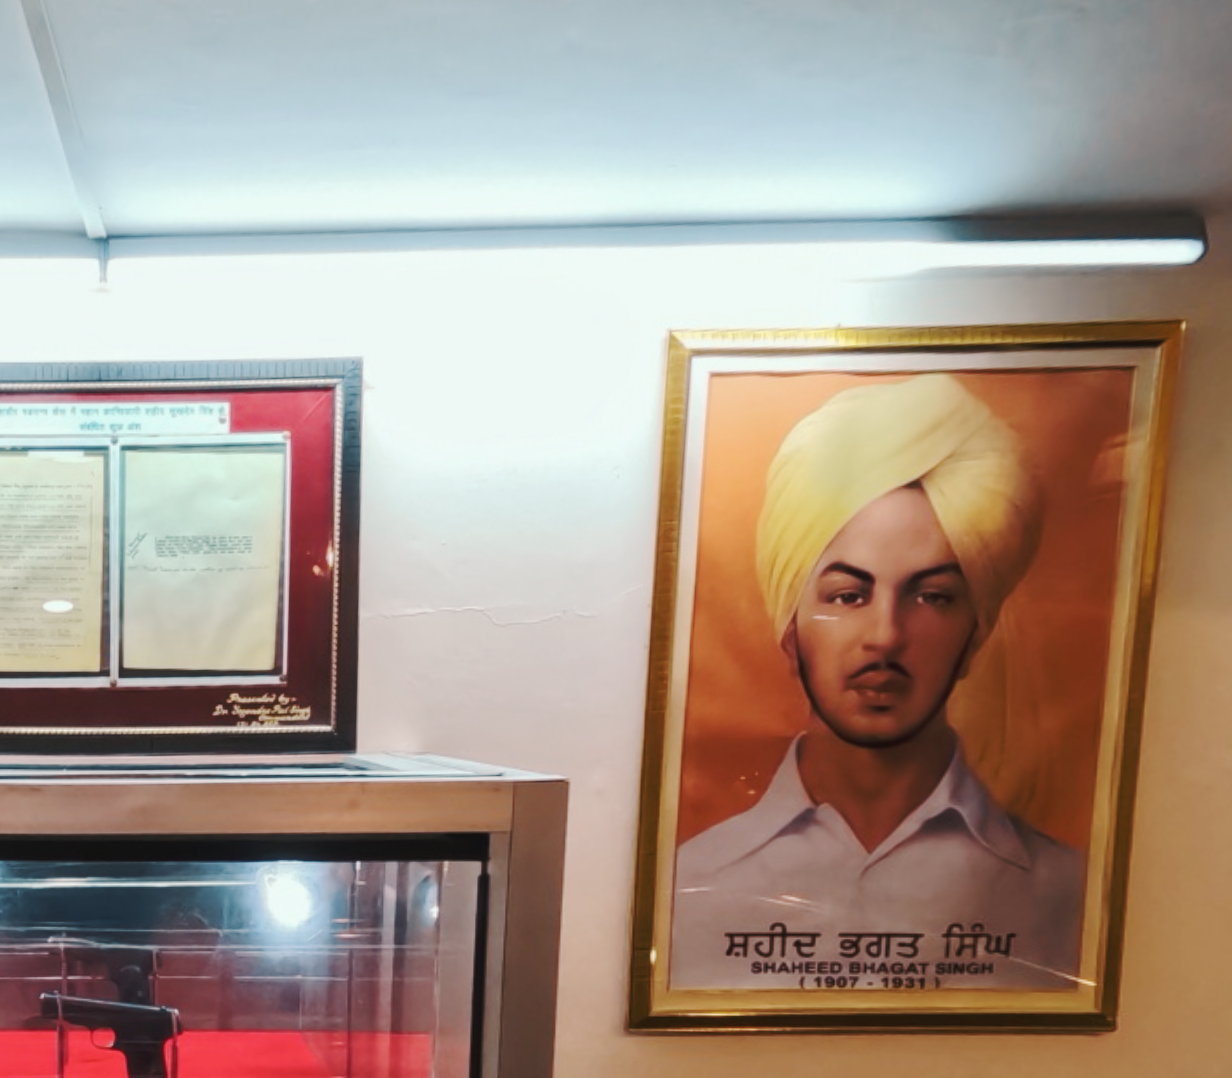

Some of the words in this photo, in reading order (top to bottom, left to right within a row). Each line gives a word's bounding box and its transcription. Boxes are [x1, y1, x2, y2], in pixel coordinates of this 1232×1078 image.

[724, 922, 821, 958] ਸ਼ਹੀਦ
[838, 932, 925, 958] ਭਗਤ
[942, 923, 1016, 958] ਸਿੰਘ
[750, 961, 842, 974] SHAHEED
[849, 961, 929, 975] BHAGAT
[935, 962, 994, 975] SINGH
[813, 976, 860, 988] 1907
[881, 976, 926, 989] 1931
